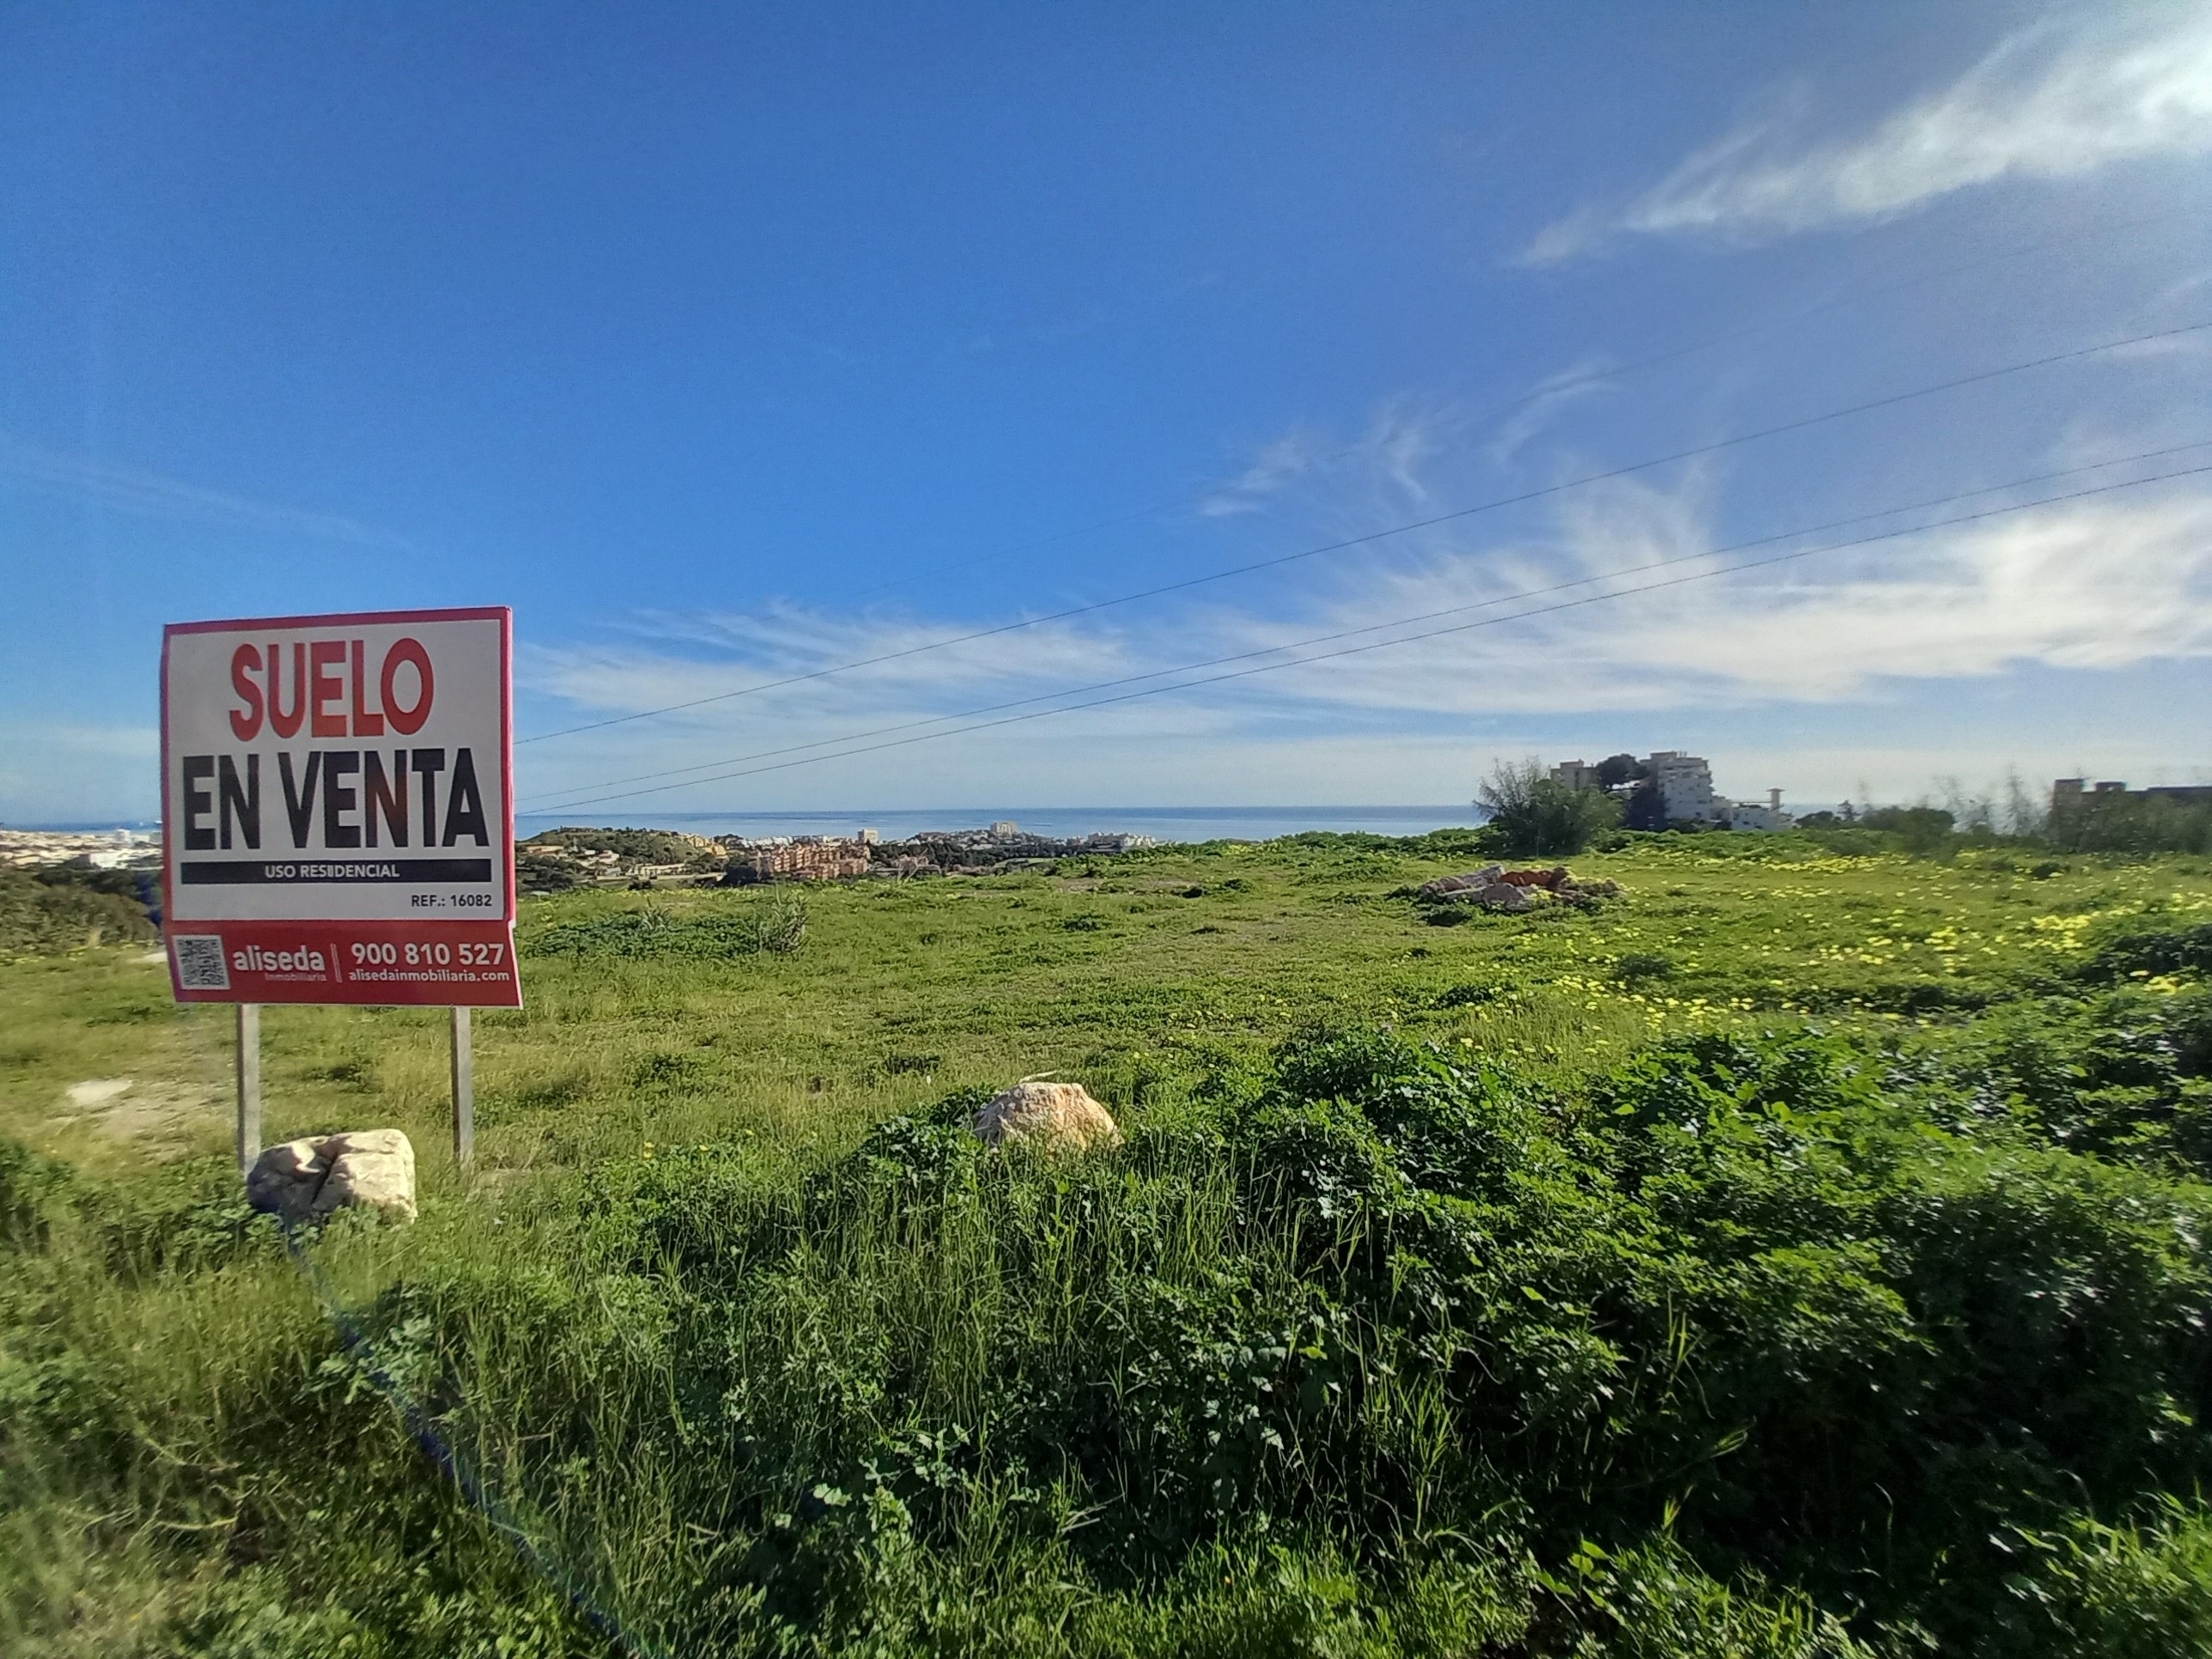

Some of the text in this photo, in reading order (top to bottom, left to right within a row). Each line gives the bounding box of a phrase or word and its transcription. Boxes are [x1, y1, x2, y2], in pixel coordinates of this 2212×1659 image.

[229, 637, 434, 741] SUELO
[183, 748, 489, 850] EN VENTA
[264, 864, 400, 878] USO RESIDENCIAL
[411, 894, 492, 907] REF.: 16082
[234, 945, 325, 971] aliseda
[350, 943, 505, 965] 900 810 527
[349, 969, 510, 982] alisedainmobiliaria.com
